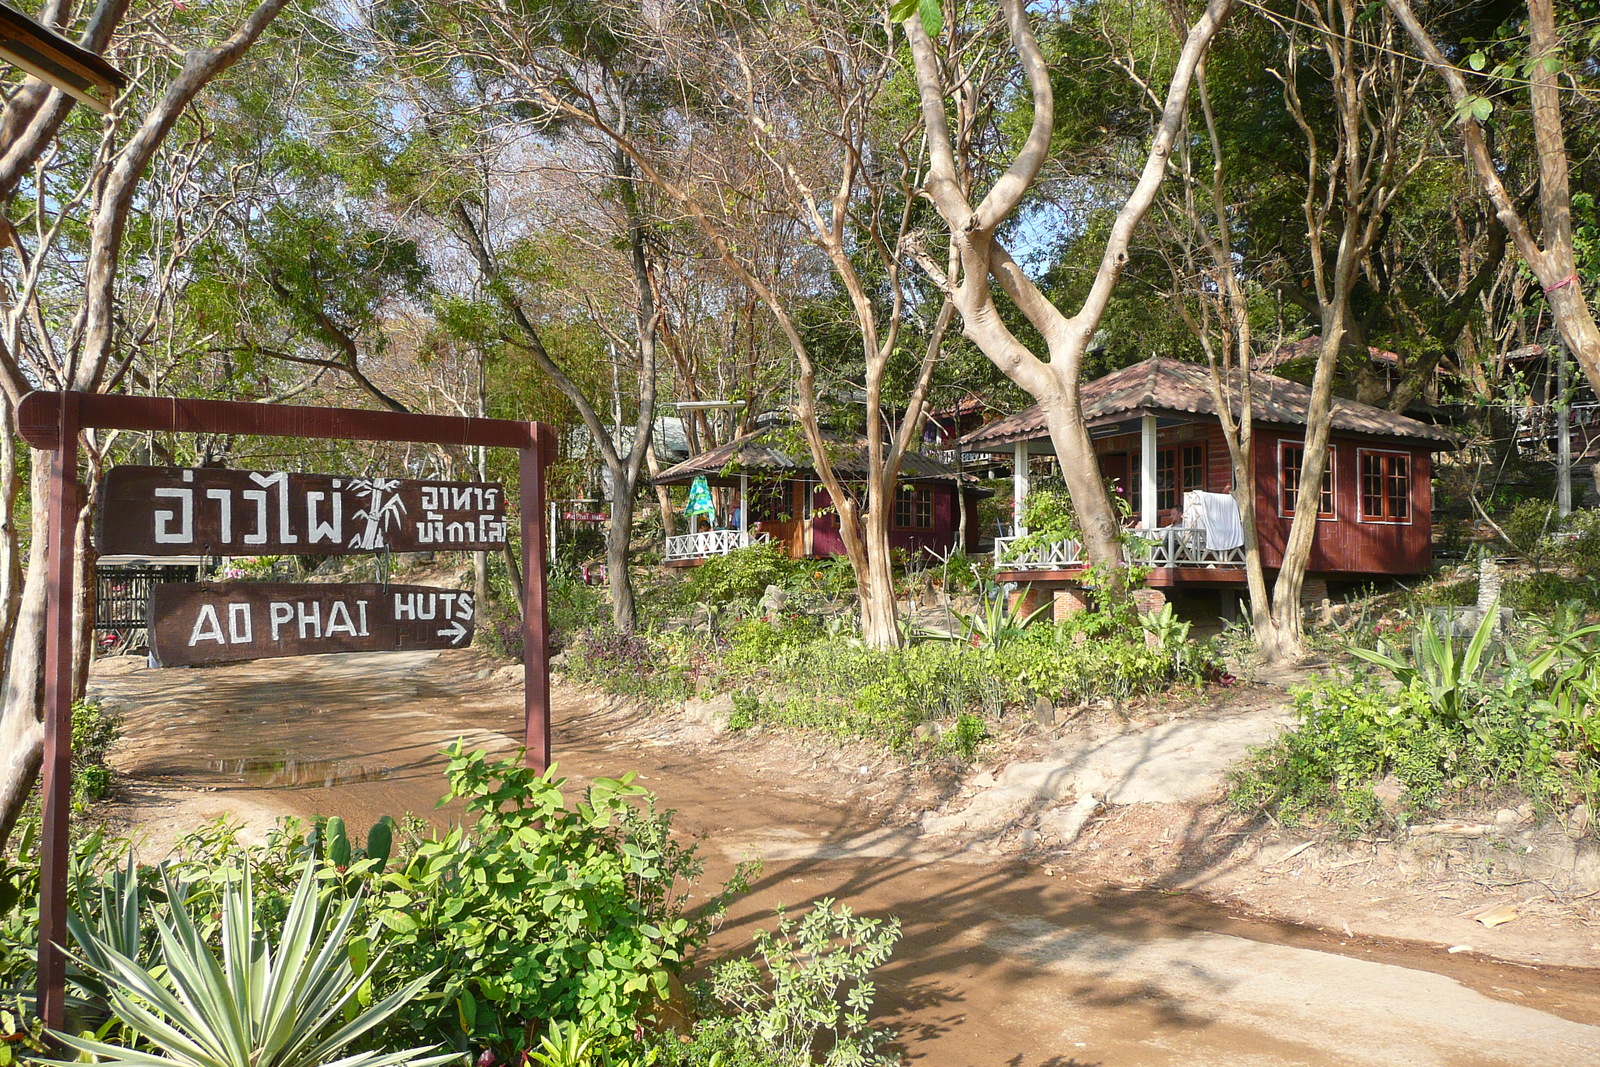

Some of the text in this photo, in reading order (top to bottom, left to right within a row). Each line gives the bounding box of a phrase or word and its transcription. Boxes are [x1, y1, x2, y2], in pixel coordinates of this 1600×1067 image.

[154, 469, 342, 544] อ่าวไผ่
[421, 486, 499, 511] อาหาร
[188, 602, 253, 647] AO
[270, 600, 370, 641] PHAI
[394, 593, 474, 621] HUTS
